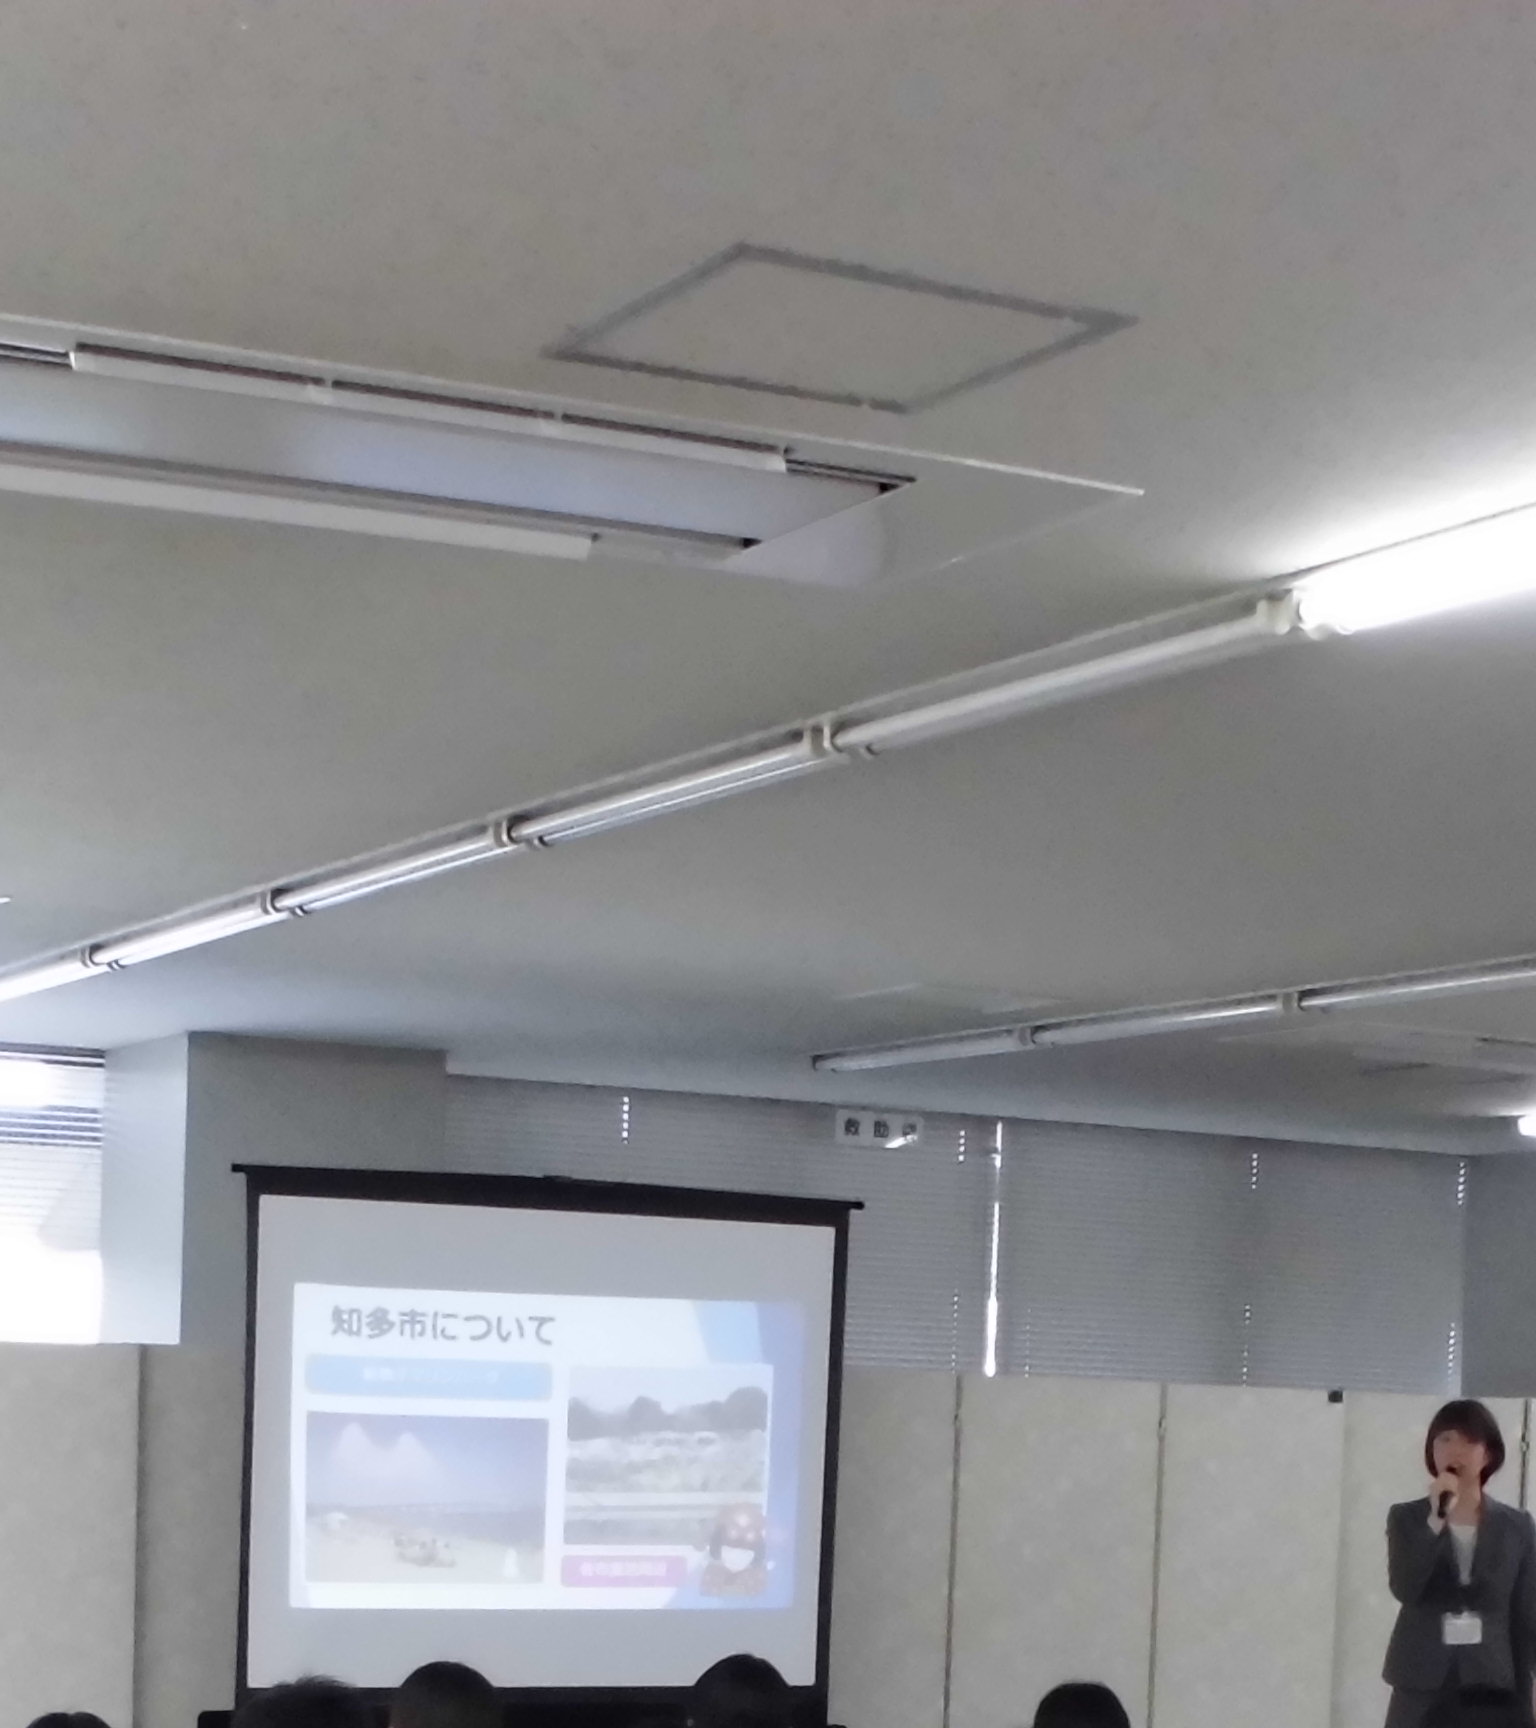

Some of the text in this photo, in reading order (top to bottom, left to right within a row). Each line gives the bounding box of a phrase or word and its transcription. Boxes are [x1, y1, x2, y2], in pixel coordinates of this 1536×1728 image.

[331, 1304, 556, 1345] 知多市について
